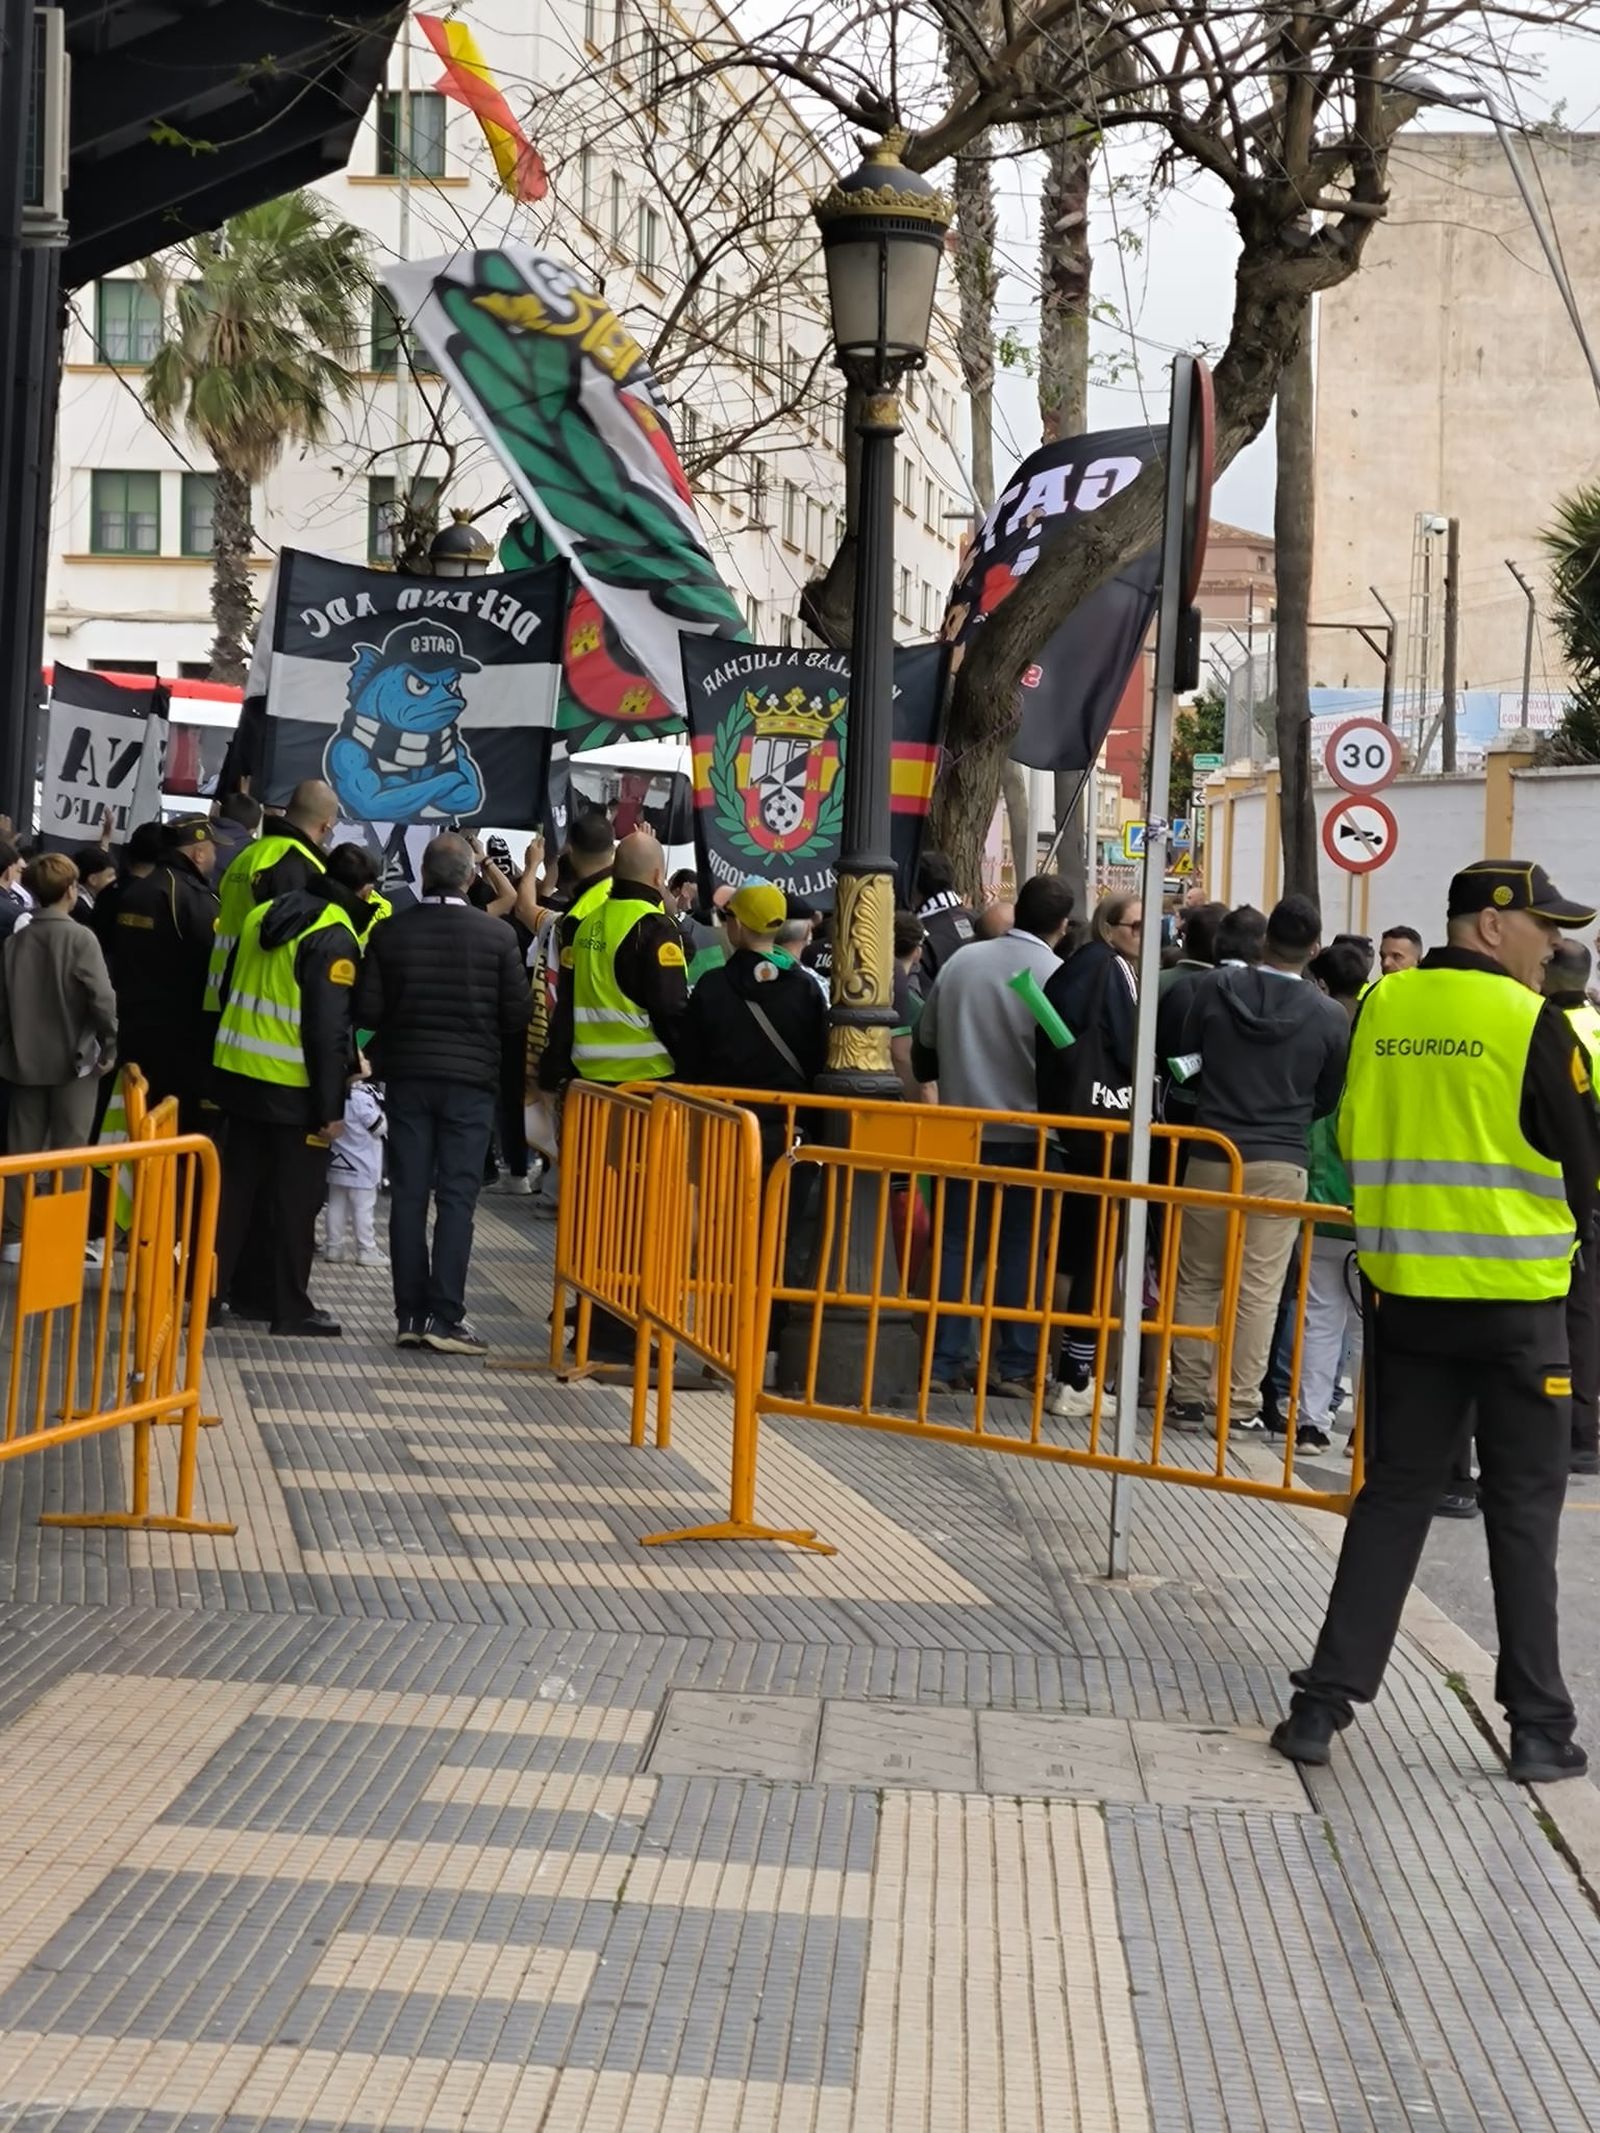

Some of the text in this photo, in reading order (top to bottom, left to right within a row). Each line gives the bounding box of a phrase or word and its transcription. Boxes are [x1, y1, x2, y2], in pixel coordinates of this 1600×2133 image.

[1343, 744, 1385, 769] 30
[1375, 1038, 1484, 1058] SEGURIDAD
[1092, 1081, 1133, 1109] KAR
